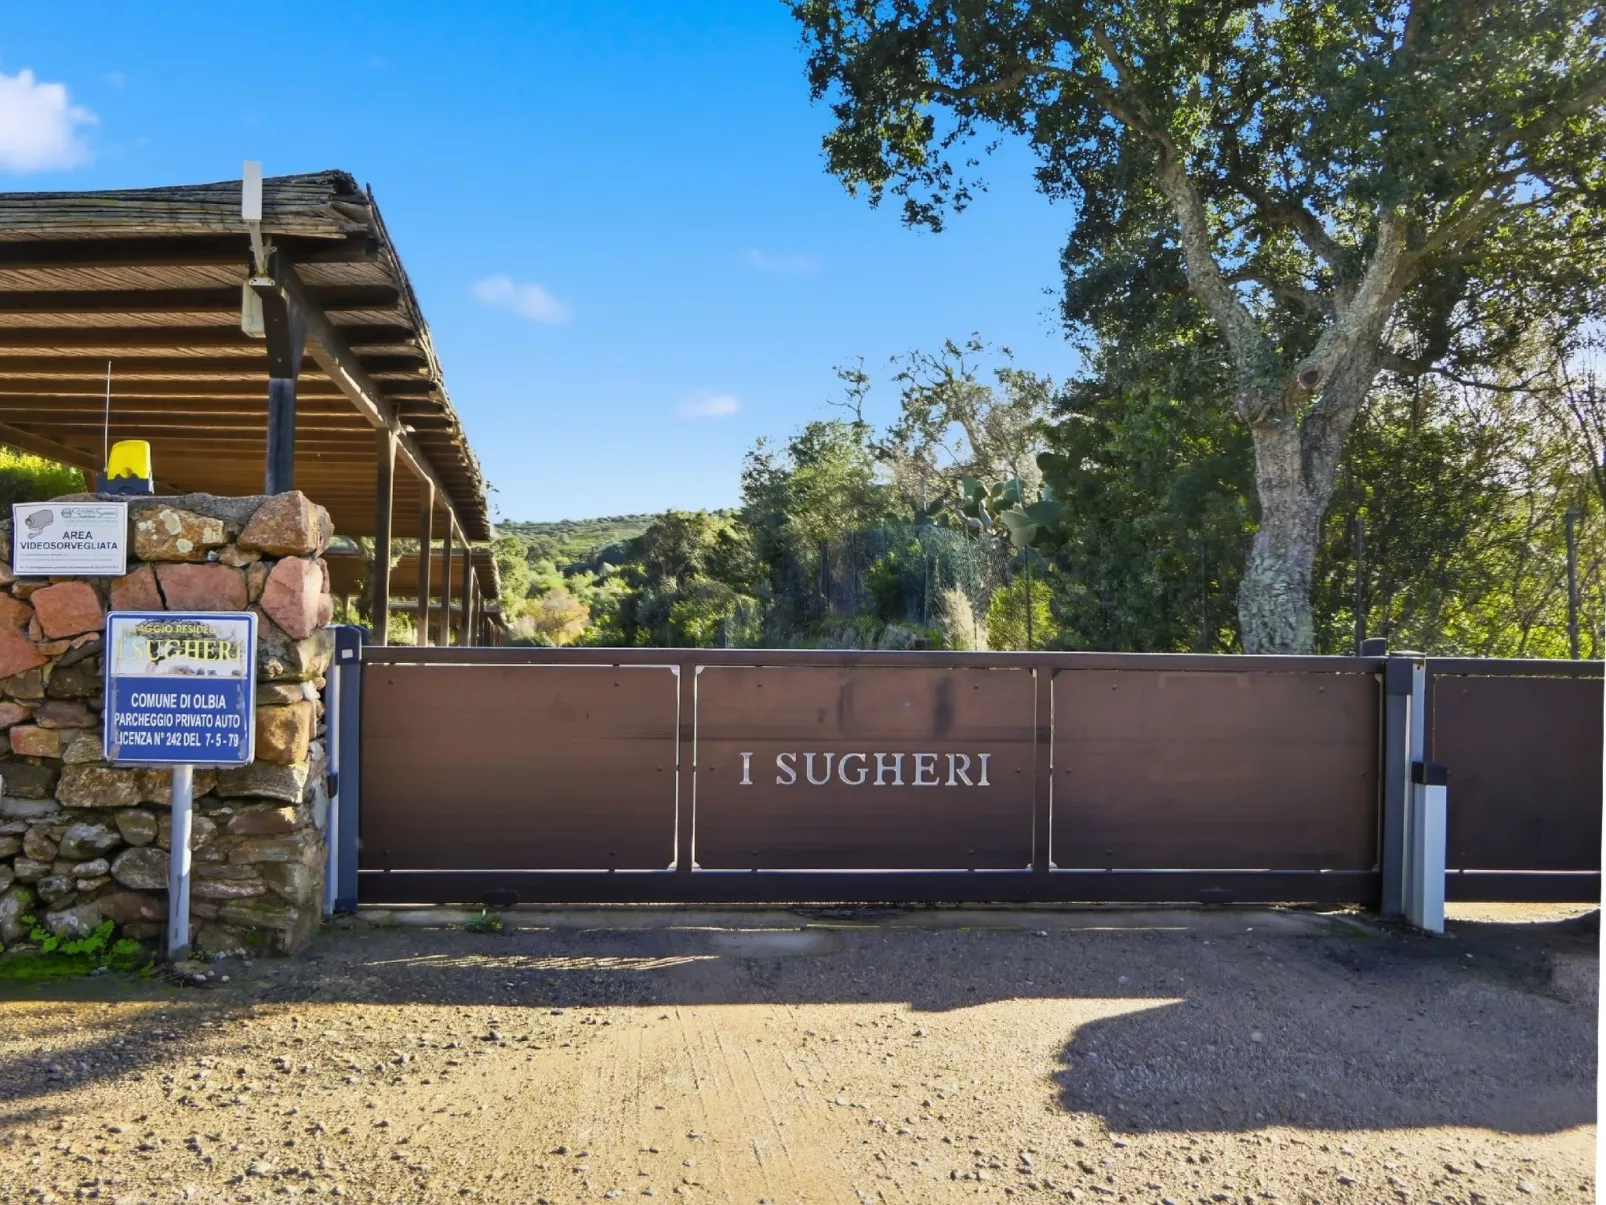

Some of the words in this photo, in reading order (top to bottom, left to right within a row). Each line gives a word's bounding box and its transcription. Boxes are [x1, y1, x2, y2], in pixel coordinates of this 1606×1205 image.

[62, 531, 93, 540] AREA
[20, 542, 118, 550] VIDEOSORVEGLIATA
[131, 639, 242, 661] SUGHERI
[131, 693, 177, 708] COMUNE
[180, 694, 190, 708] DI
[193, 694, 226, 709] OLBIA
[114, 712, 173, 727] PARCHEGGIO
[175, 714, 213, 728] PRIVATO
[214, 715, 240, 728] AUTO
[166, 732, 182, 746] 242
[183, 733, 201, 746] DEL
[739, 752, 754, 785] I
[775, 752, 992, 786] SUGHERI
